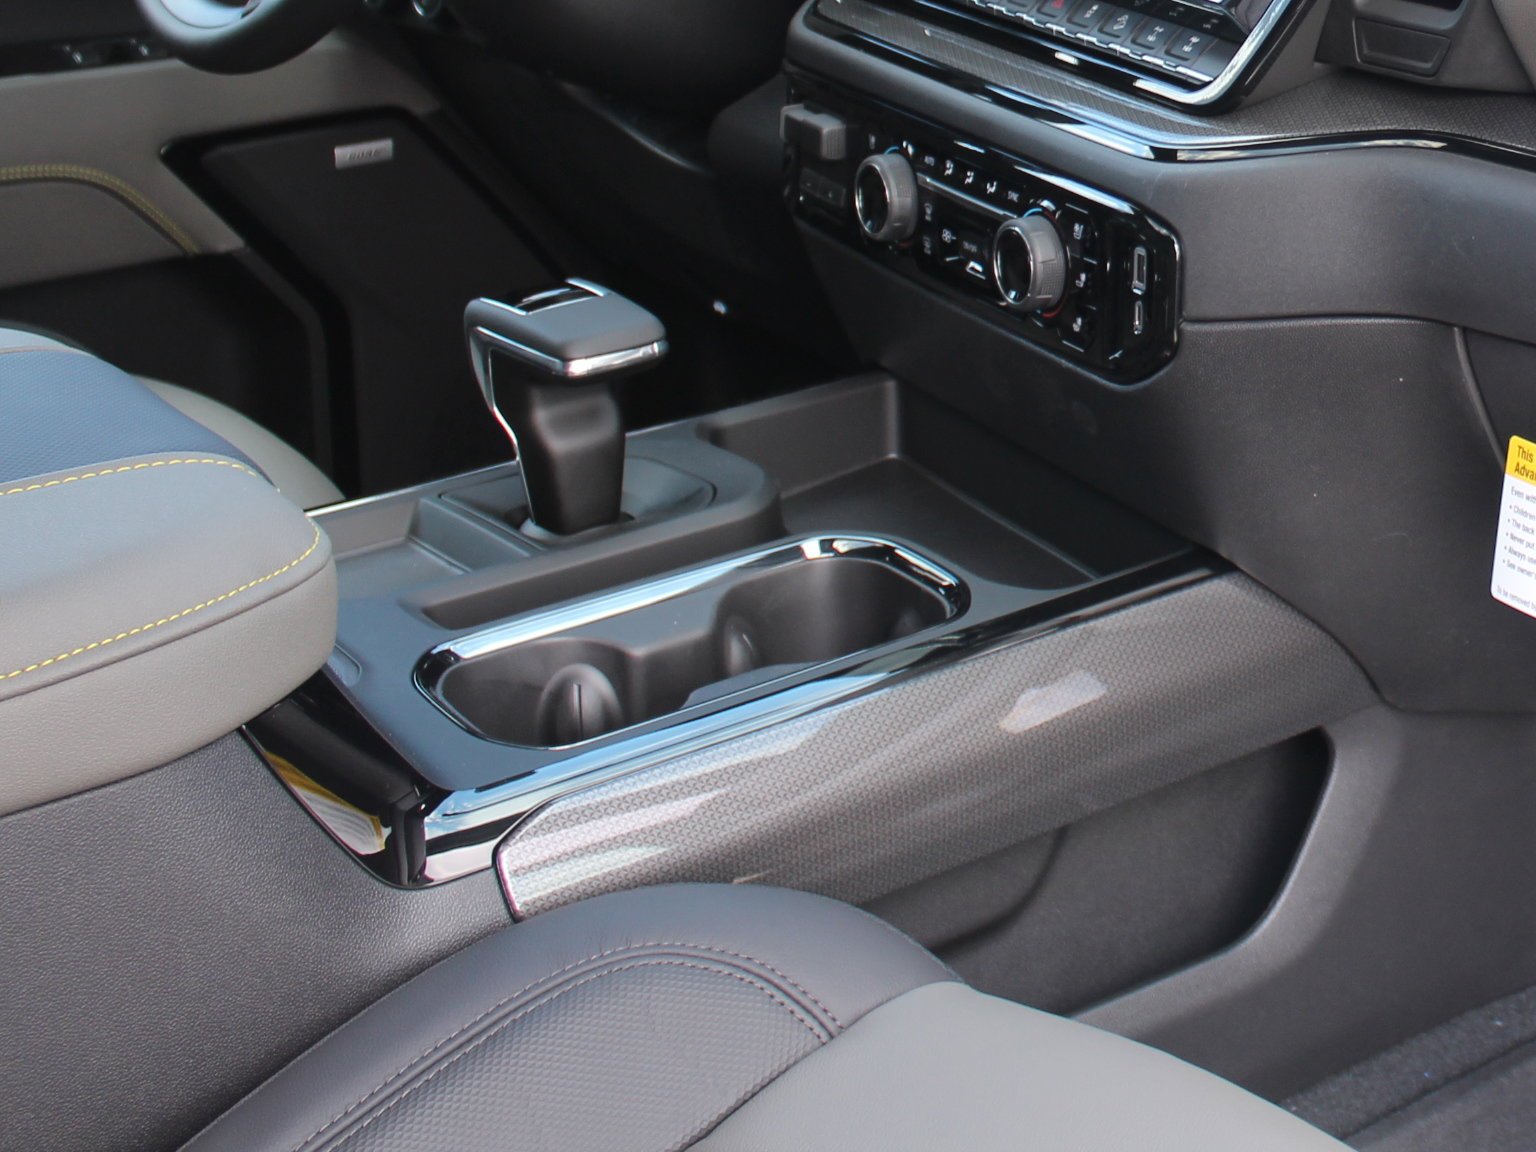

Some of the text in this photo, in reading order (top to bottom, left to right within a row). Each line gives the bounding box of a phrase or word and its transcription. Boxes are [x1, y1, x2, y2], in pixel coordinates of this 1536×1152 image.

[1518, 445, 1533, 463] This
[1511, 486, 1524, 499] Even
[1513, 505, 1536, 521] Children
[1512, 518, 1521, 530] The
[1522, 524, 1535, 535] back
[1510, 532, 1525, 545] Never
[1525, 541, 1535, 551] put
[1508, 546, 1526, 561] Always
[1507, 558, 1516, 570] See
[1503, 588, 1509, 597] be
[1509, 593, 1531, 608] removed
